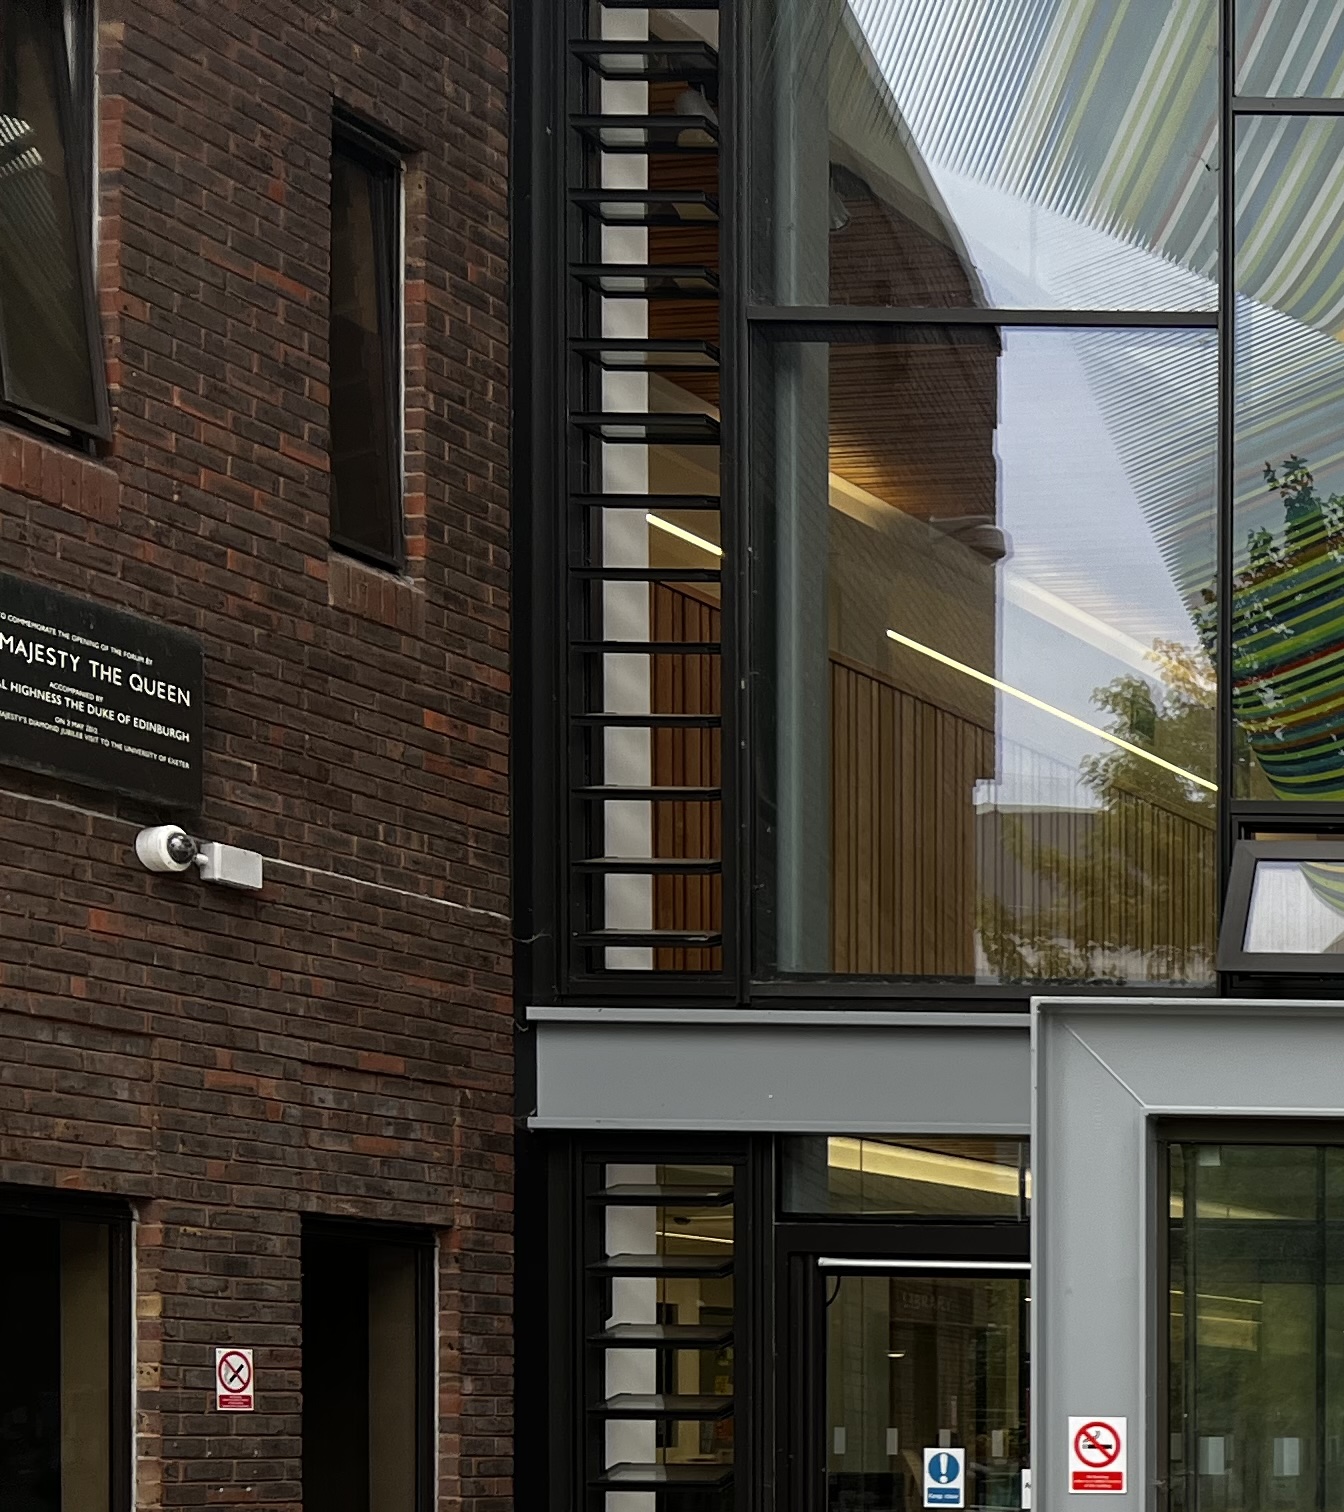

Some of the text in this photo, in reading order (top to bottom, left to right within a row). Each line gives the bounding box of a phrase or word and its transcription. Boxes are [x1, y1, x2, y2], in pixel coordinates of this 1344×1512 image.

[0, 631, 191, 707] MAJESTY THE QUEEN
[10, 681, 62, 705] HIGHNESS
[64, 696, 85, 712] THE
[87, 703, 115, 721] DUKE
[117, 712, 131, 725] OF
[133, 717, 190, 743] EDINBURGH
